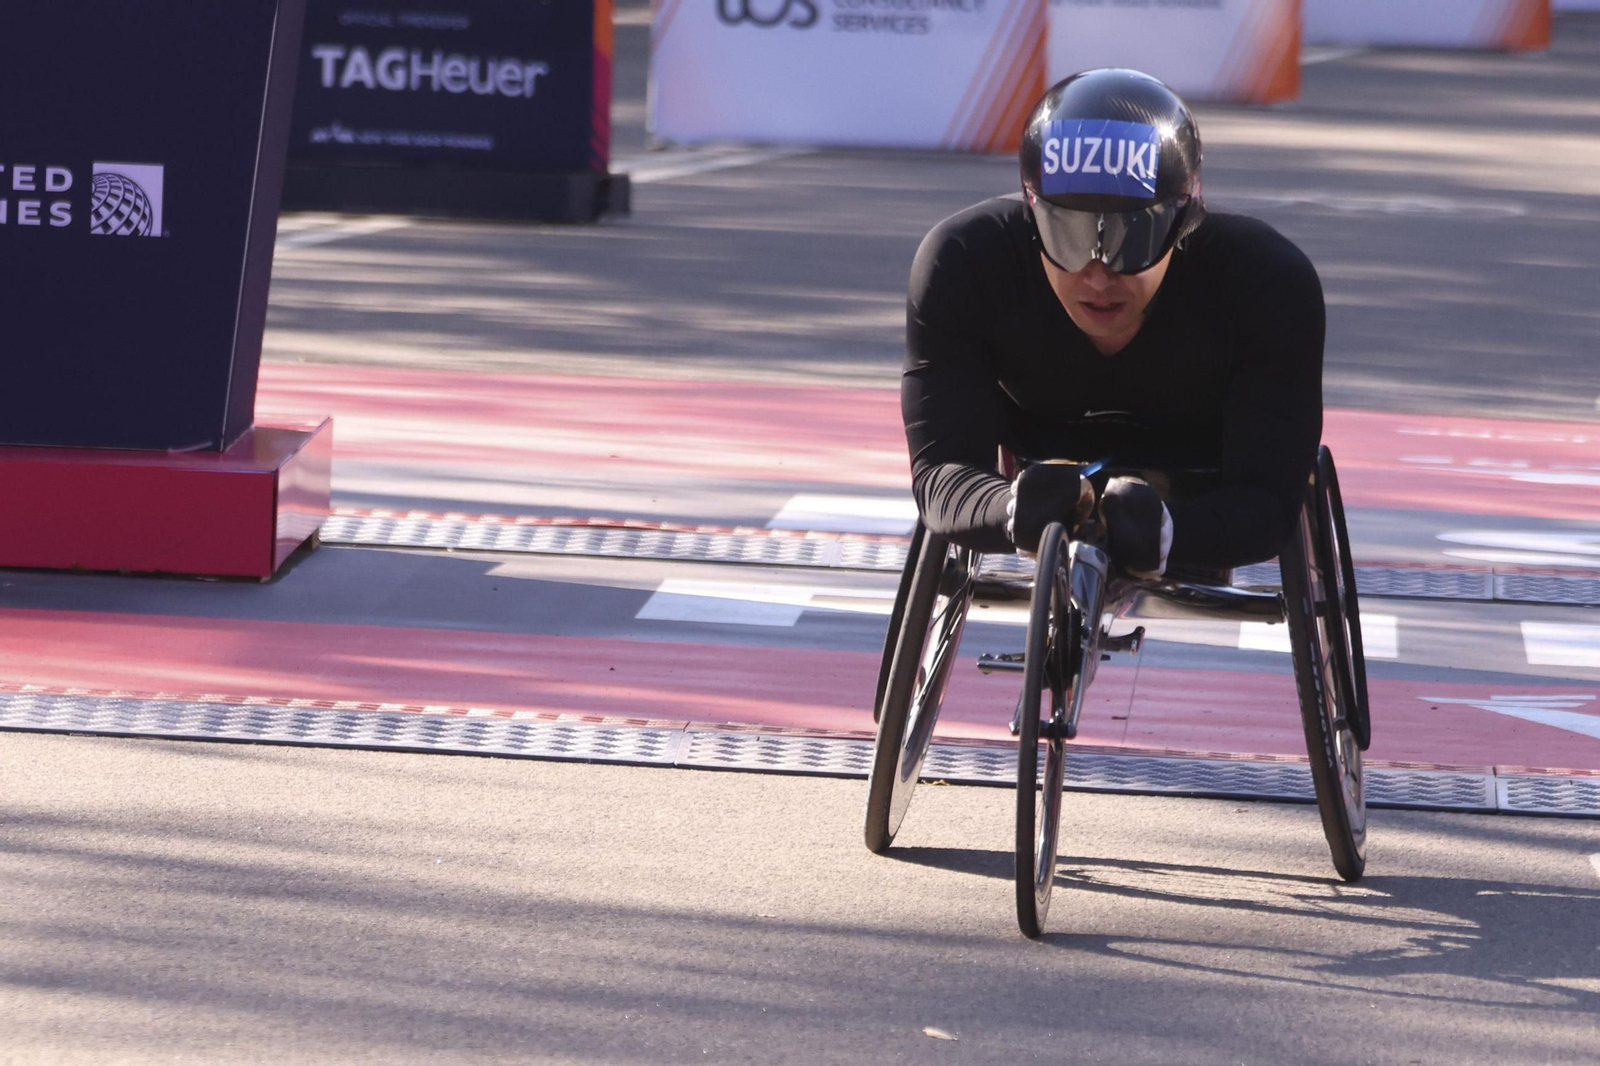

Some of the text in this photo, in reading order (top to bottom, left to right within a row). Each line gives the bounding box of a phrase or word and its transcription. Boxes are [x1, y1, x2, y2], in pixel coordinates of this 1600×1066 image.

[833, 14, 930, 34] SERVICES
[1043, 136, 1157, 180] SUZUKI
[0, 164, 73, 193] ED
[0, 199, 72, 227] ES
